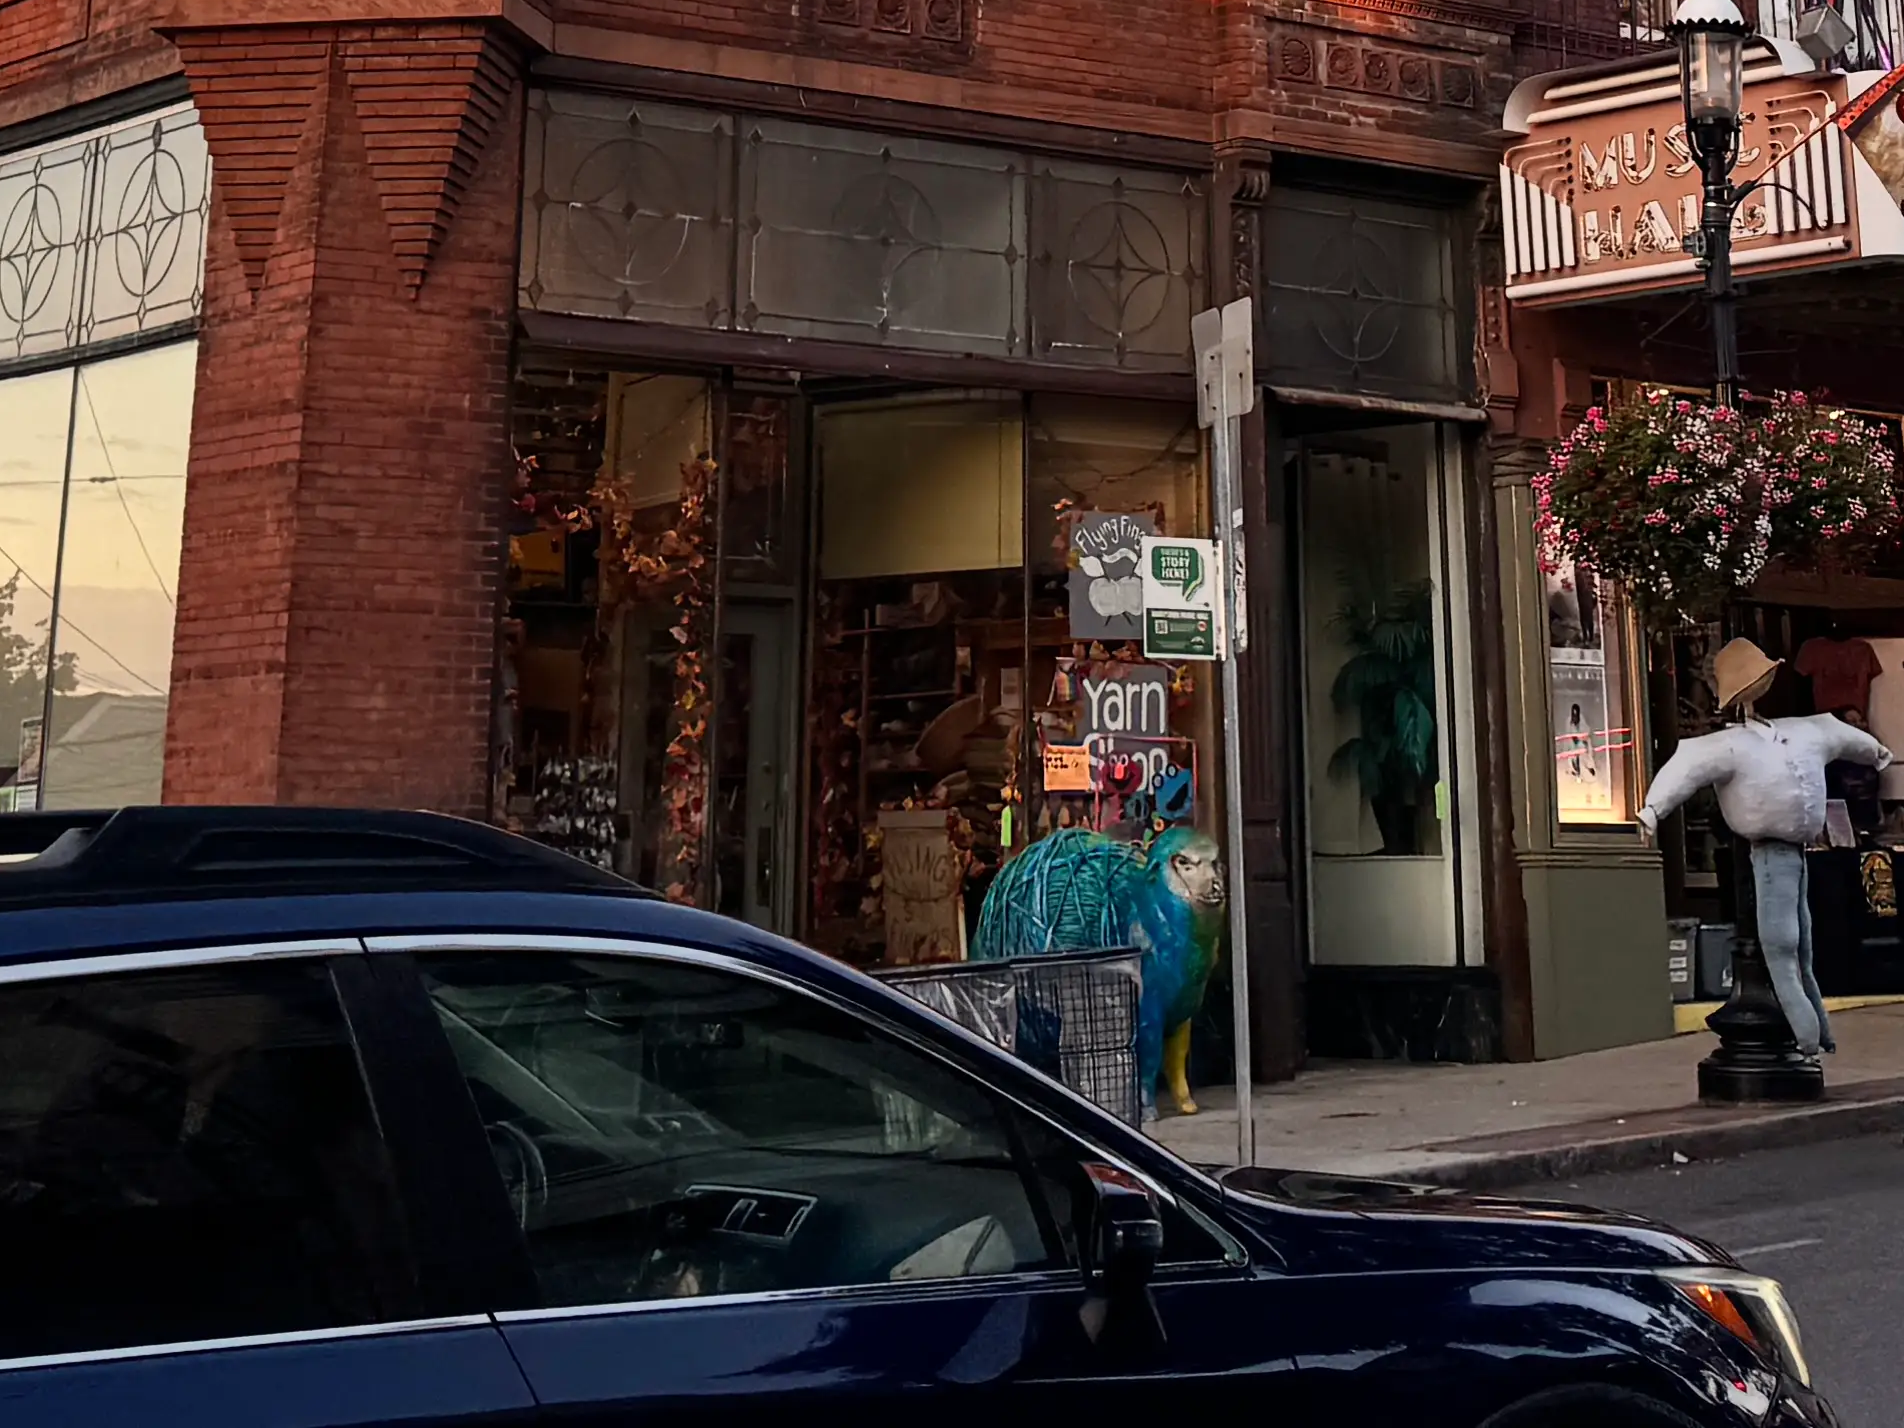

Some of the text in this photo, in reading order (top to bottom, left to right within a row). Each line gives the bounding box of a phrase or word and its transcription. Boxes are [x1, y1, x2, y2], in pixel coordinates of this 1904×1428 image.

[1579, 111, 1761, 193] MUSC
[1074, 518, 1119, 553] Flying
[1082, 677, 1166, 734] Yarn
